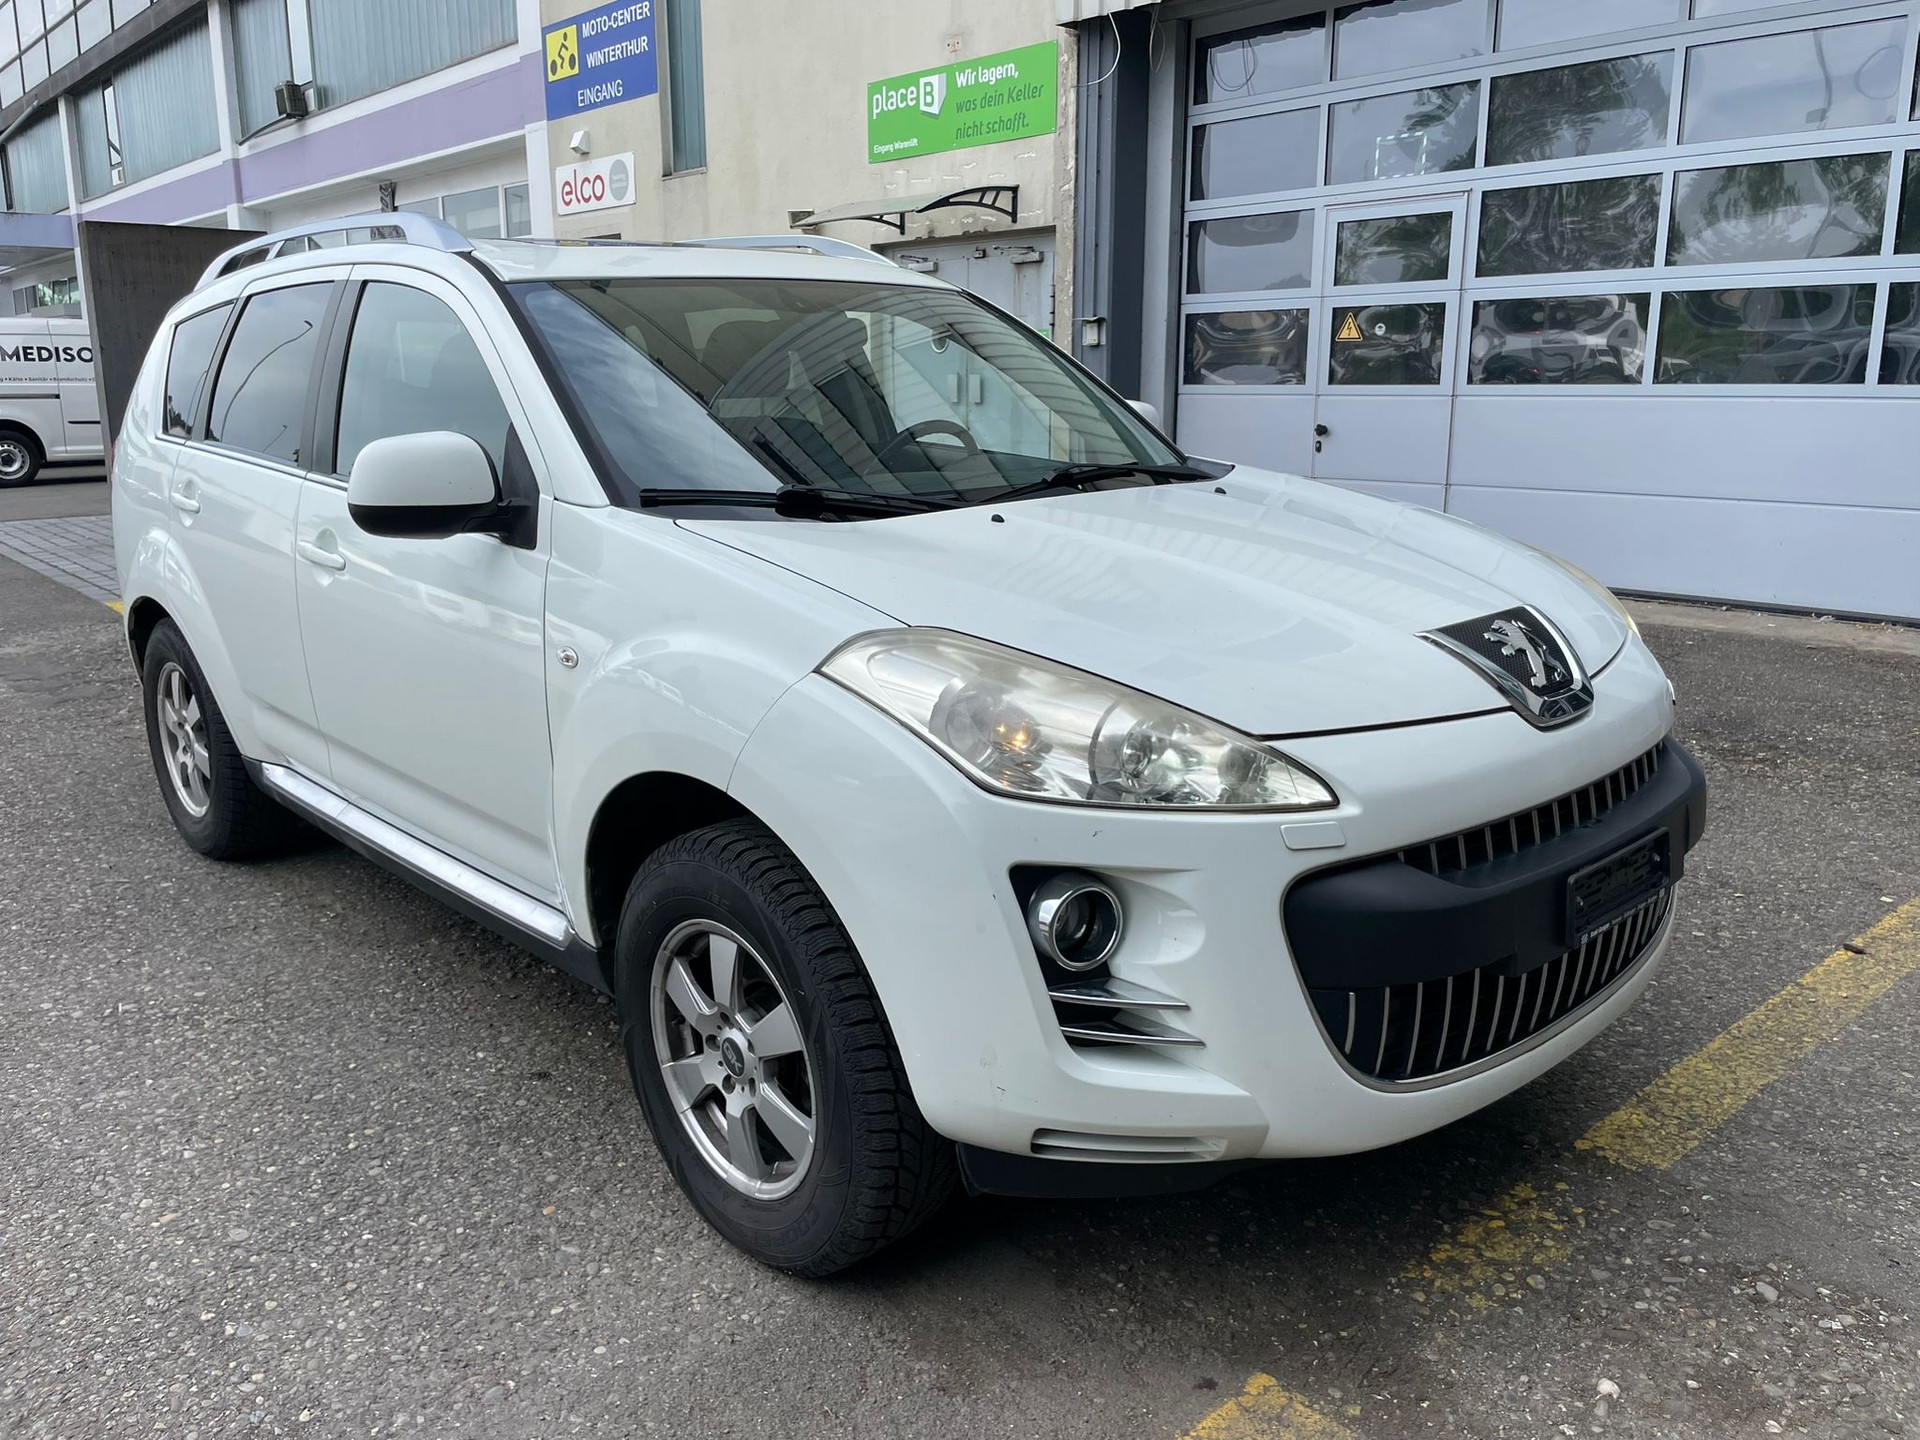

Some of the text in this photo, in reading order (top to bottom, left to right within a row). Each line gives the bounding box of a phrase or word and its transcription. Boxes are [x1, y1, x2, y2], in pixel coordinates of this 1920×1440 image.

[582, 1, 651, 38] MOTO-CENTER
[586, 35, 649, 69] WINTERTHUR
[955, 62, 1019, 88] Wir lagern,
[577, 79, 624, 107] EINGANG
[955, 83, 1045, 114] was dein Keller
[955, 112, 1030, 140] nicht schafft.
[561, 168, 606, 207] elco
